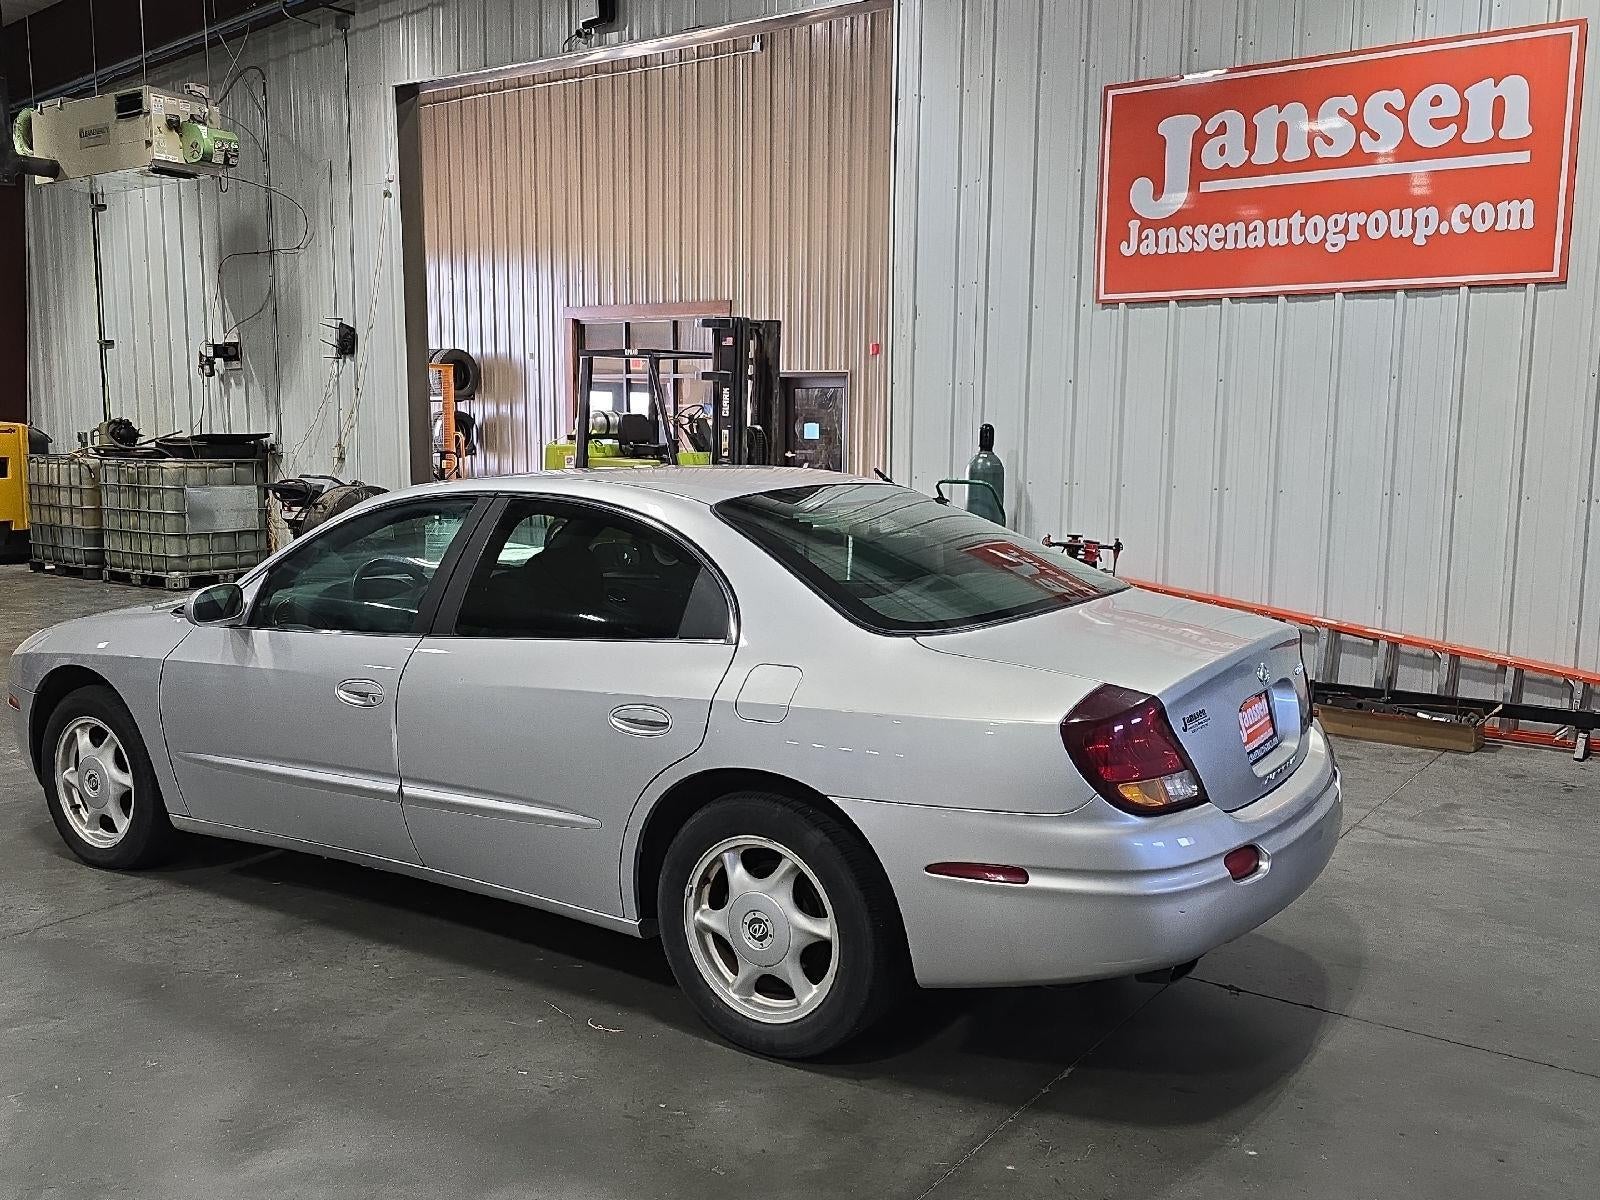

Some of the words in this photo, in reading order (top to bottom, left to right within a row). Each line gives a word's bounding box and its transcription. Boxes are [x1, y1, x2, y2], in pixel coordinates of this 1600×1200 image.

[1129, 73, 1533, 220] Janssen
[1119, 197, 1534, 257] Janssenautogroup.com
[721, 387, 730, 417] CLARK
[1238, 697, 1269, 743] Janssen
